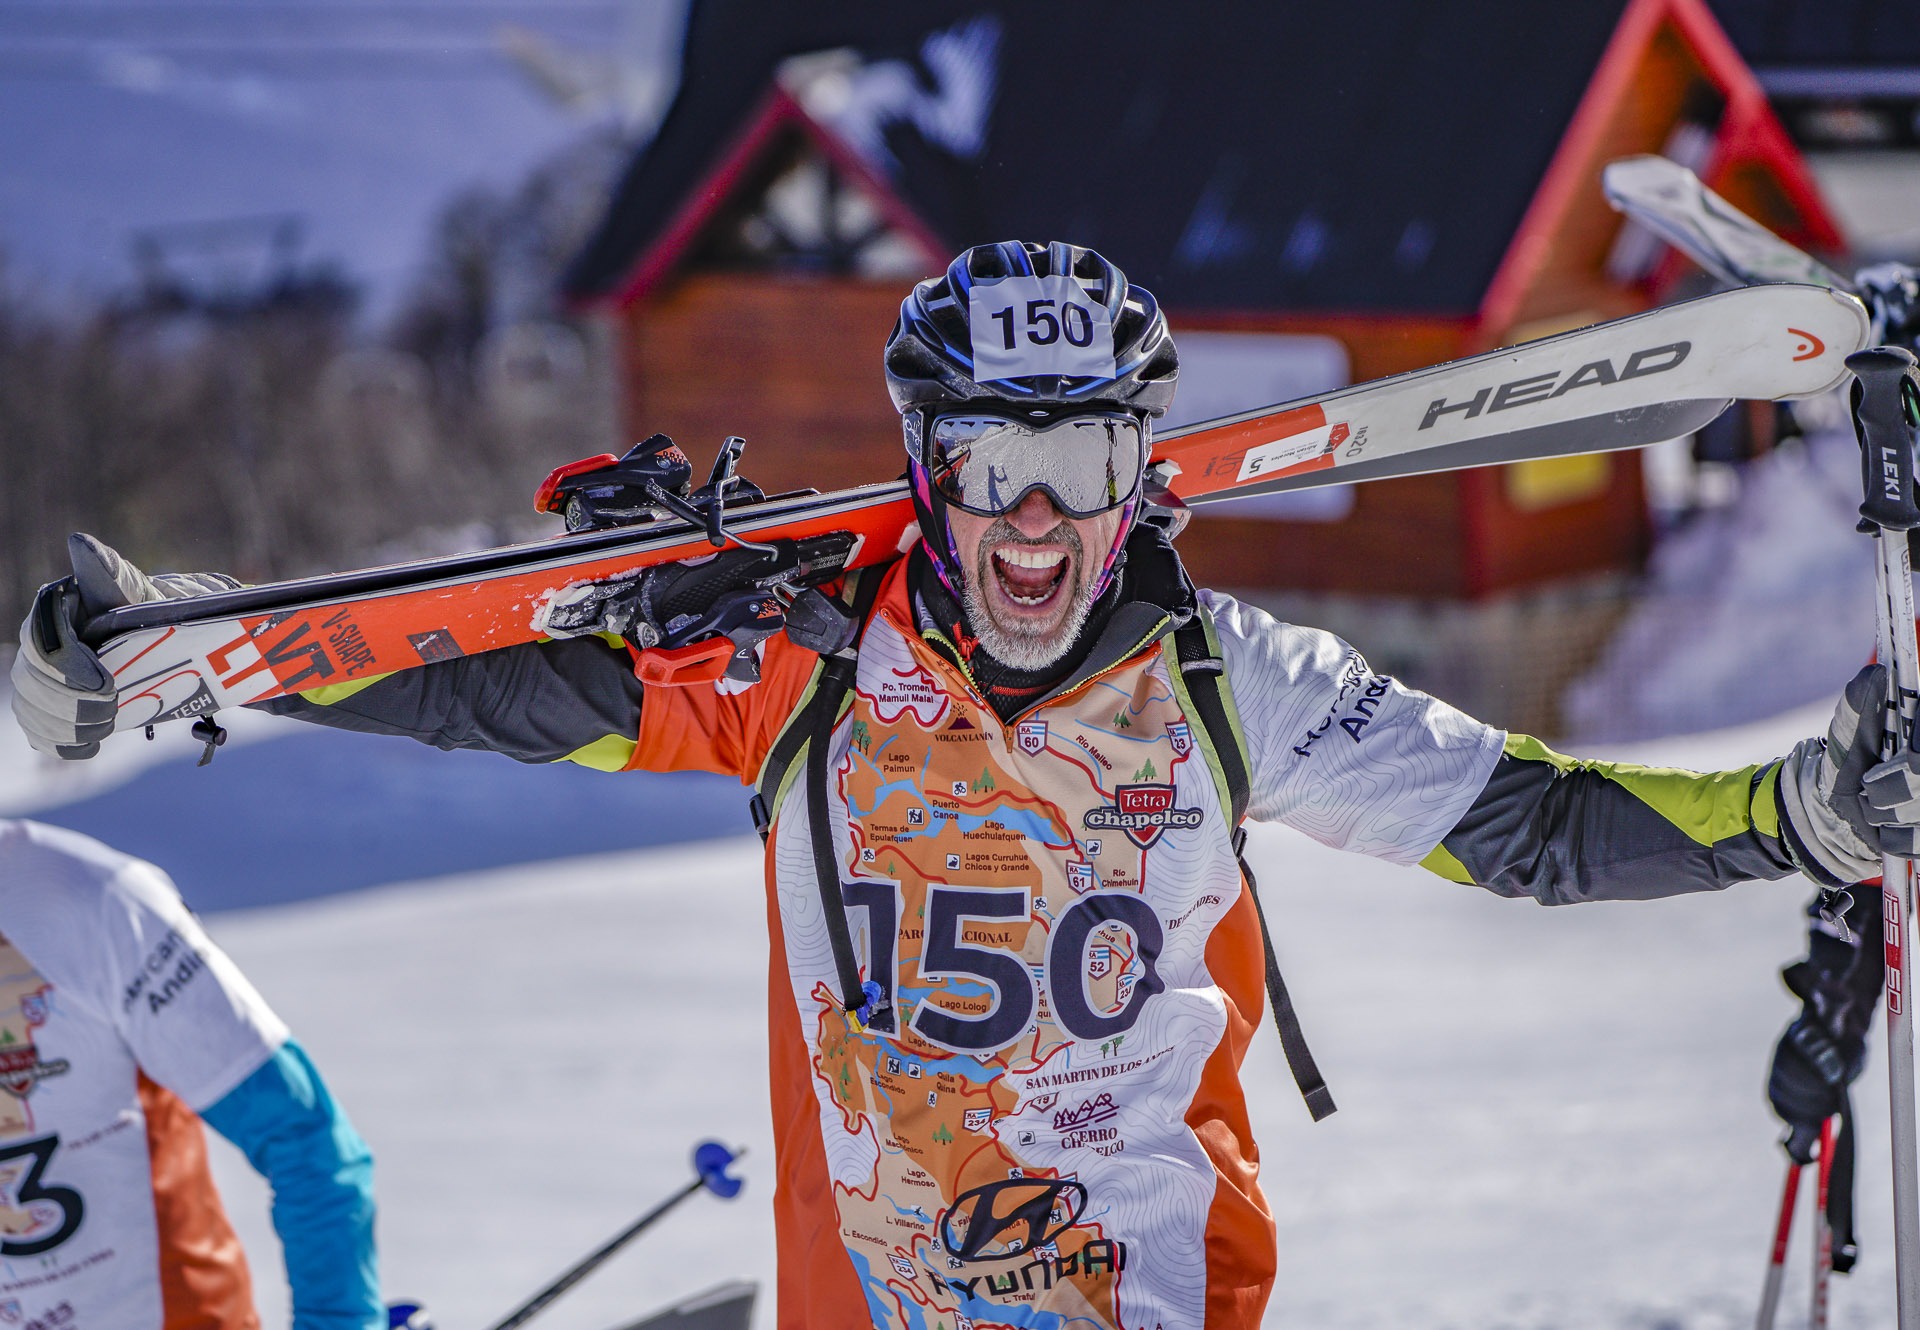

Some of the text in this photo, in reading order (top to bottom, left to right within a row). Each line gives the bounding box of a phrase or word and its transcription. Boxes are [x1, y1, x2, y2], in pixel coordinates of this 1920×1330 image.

[992, 300, 1094, 350] 150
[1418, 341, 1692, 430] HEAD
[1249, 458, 1264, 474] 5
[1882, 446, 1900, 501] LEKI
[321, 608, 376, 676] V-SHAPE
[882, 683, 930, 692] Po. Tromen
[879, 694, 934, 704] Mamuil Malal
[170, 692, 212, 720] TECH
[968, 732, 994, 742] LANÍN
[1024, 737, 1039, 748] 60
[1174, 739, 1186, 750] 23
[888, 753, 910, 763] Lago
[1075, 735, 1112, 770] Río Malleo
[884, 764, 915, 773] Paimun
[932, 800, 960, 809] Puerto
[1124, 793, 1166, 808] Tetra
[933, 811, 959, 820] Canoa
[1087, 810, 1202, 830] chapelco
[870, 824, 910, 832] Termas de
[984, 820, 1005, 830] Lago
[870, 833, 913, 844] Epulafquen
[963, 832, 1026, 842] Huechulafquen
[966, 853, 990, 862] Lagos
[964, 864, 992, 872] Chicos
[1001, 864, 1030, 872] Grande
[1112, 868, 1126, 877] Río
[1072, 876, 1086, 888] 61
[1168, 917, 1182, 930] DE
[843, 882, 1165, 1048] 150
[1090, 962, 1104, 972] 52
[940, 1000, 987, 1013] Lago Lolog
[908, 1036, 926, 1046] Lago
[876, 1072, 894, 1084] Lago
[937, 1072, 955, 1083] Quila
[1026, 1076, 1050, 1090] SAN
[1051, 1069, 1100, 1086] MARTIN
[1101, 1066, 1118, 1078] DE
[1120, 1058, 1142, 1074] LOS
[870, 1078, 906, 1095] Escondido
[936, 1082, 956, 1094] Quina
[968, 1118, 986, 1127] 234
[893, 1132, 910, 1144] Lago
[1069, 1127, 1118, 1144] CERRO
[906, 1168, 926, 1178] Lago
[901, 1176, 936, 1188] Hermoso
[886, 1216, 926, 1231] L. Villarino
[844, 1228, 888, 1247] L. Escondido
[896, 1266, 912, 1274] 234
[1013, 1292, 1036, 1302] Traful
